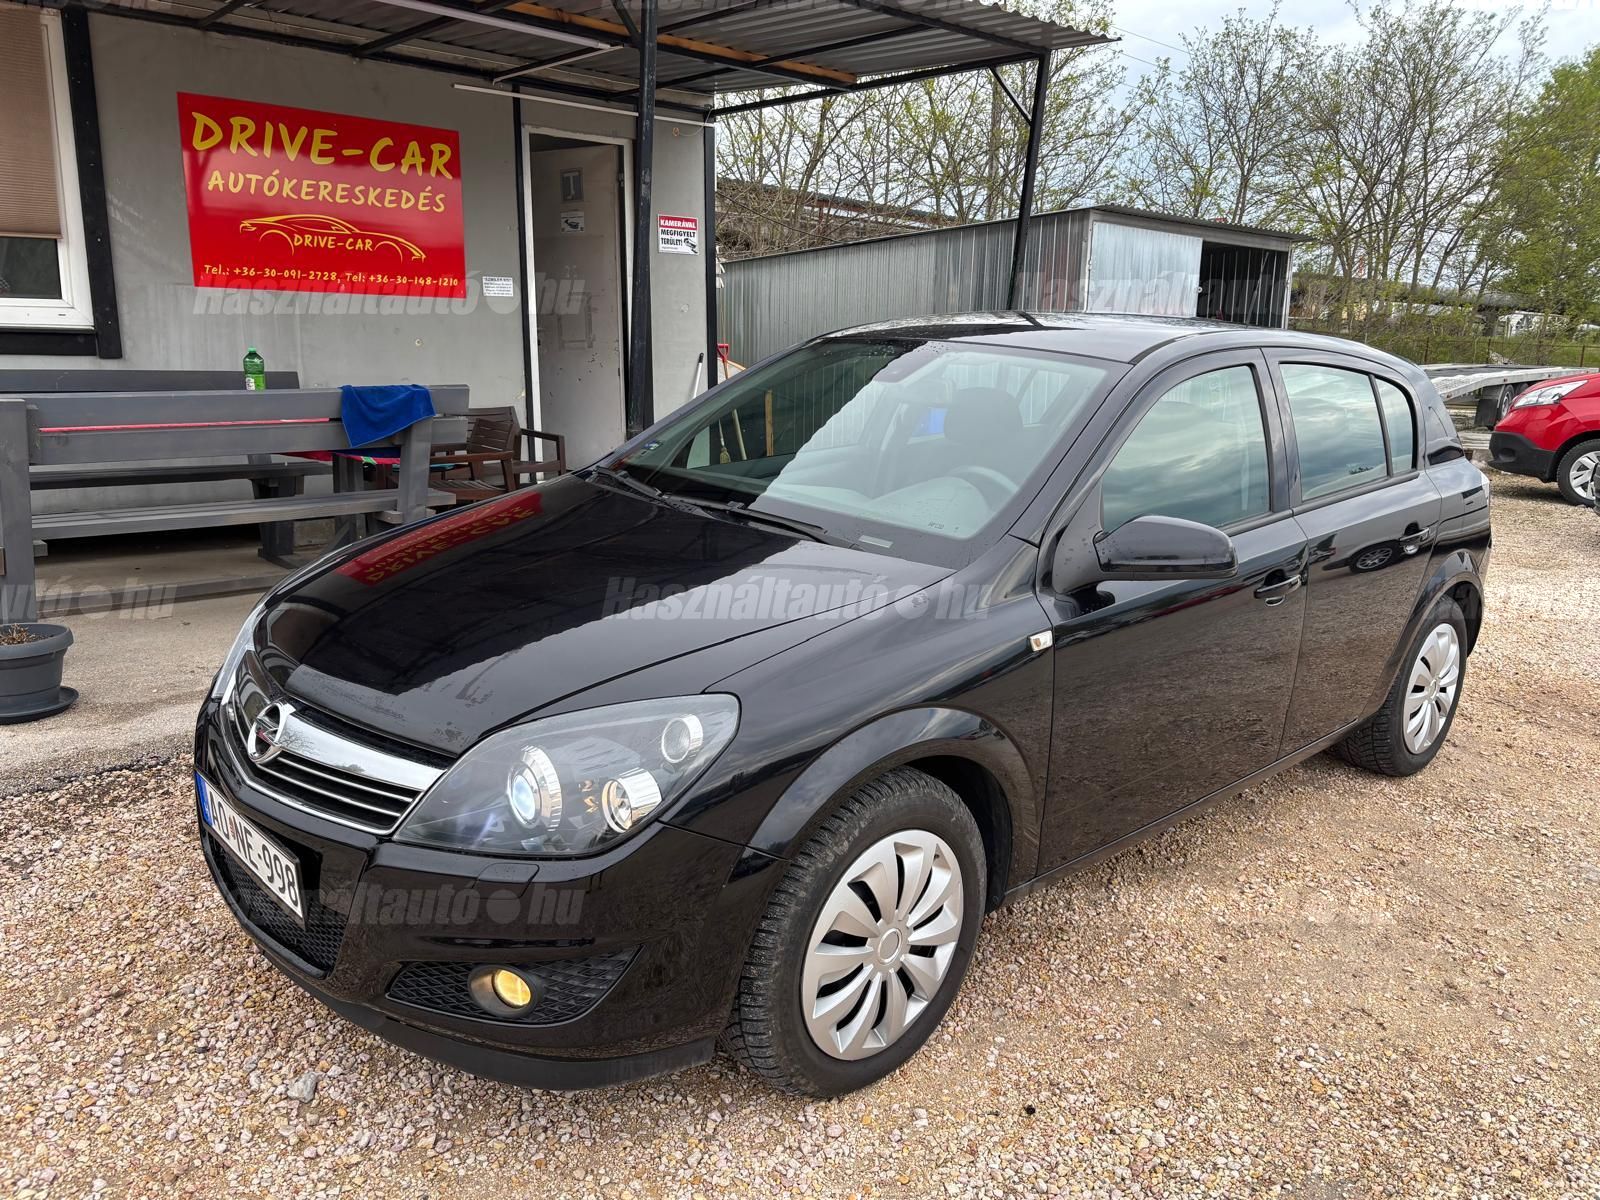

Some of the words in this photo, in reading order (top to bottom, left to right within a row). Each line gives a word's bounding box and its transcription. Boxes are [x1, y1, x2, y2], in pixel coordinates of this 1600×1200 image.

[191, 111, 454, 180] DRIVE-CAR
[207, 169, 446, 213] AUTÓKERESKEDÉS
[660, 219, 697, 229] KAMERÁVAL
[660, 229, 696, 238] MEGFIGYELT
[293, 233, 373, 251] DRIVE-CAR
[660, 237, 683, 246] TERÜLET!
[345, 272, 366, 283] Tel:
[368, 274, 459, 287] +36-30-148-1210
